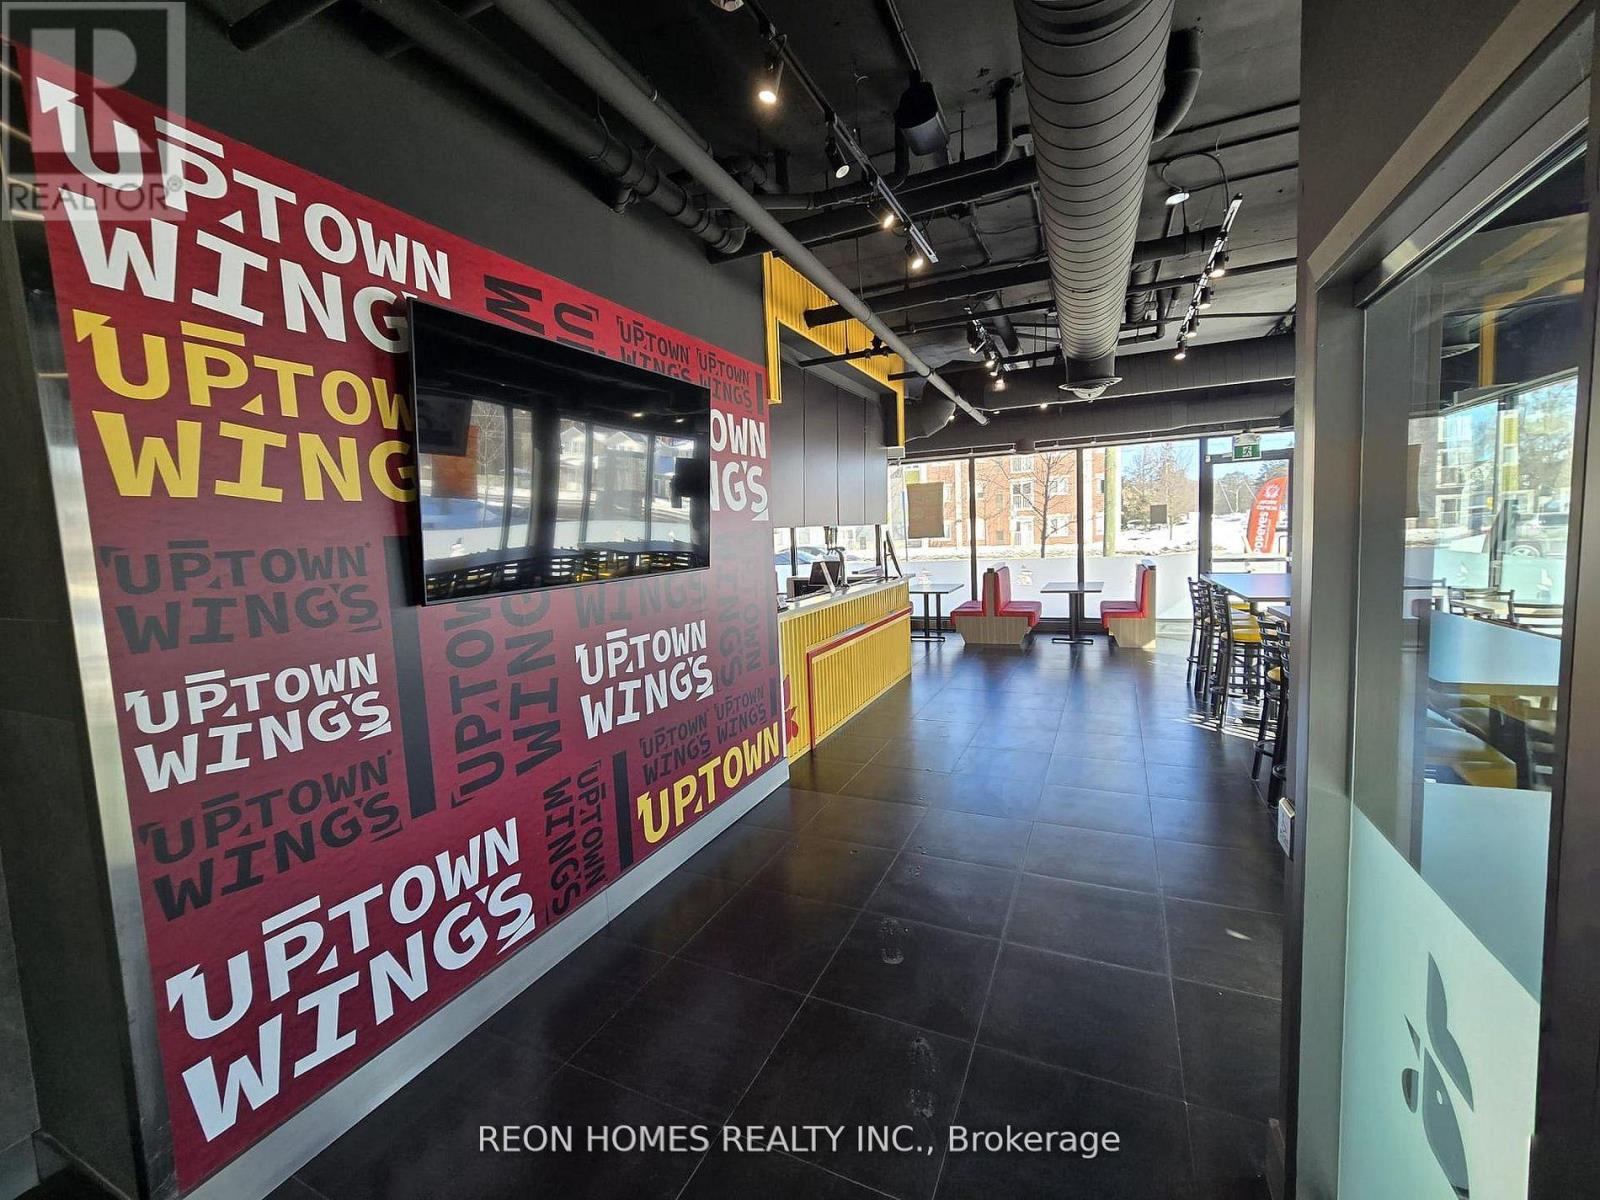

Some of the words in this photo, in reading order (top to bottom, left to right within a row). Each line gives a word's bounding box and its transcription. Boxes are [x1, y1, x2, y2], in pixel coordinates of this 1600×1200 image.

[36, 76, 452, 301] UPTOWN
[58, 187, 418, 354] WING
[72, 308, 414, 431] UPTOW
[616, 315, 691, 365] UPTOWN
[696, 347, 751, 386] UPTOWN
[92, 410, 419, 503] WING
[710, 408, 767, 459] OWN
[99, 540, 373, 595] UPTOWN
[115, 584, 382, 655] WING'S
[574, 619, 707, 686] UPTOWN
[124, 653, 378, 735] UPTOWN
[443, 599, 506, 809] UPTOW
[579, 655, 714, 740] WING'S
[639, 710, 709, 759] UPTOWN
[714, 683, 764, 721] UPTOWN
[716, 703, 768, 745] WING'S
[133, 691, 392, 793] WING'S
[636, 721, 780, 844] UPTOWN
[642, 732, 713, 786] WING'S
[138, 750, 393, 865] UPTOWN
[543, 776, 581, 927] WING'S
[576, 759, 607, 893] UPTOWN
[152, 791, 404, 922] WING'S
[165, 816, 520, 1041] UPTOWN
[182, 873, 536, 1143] WING'S
